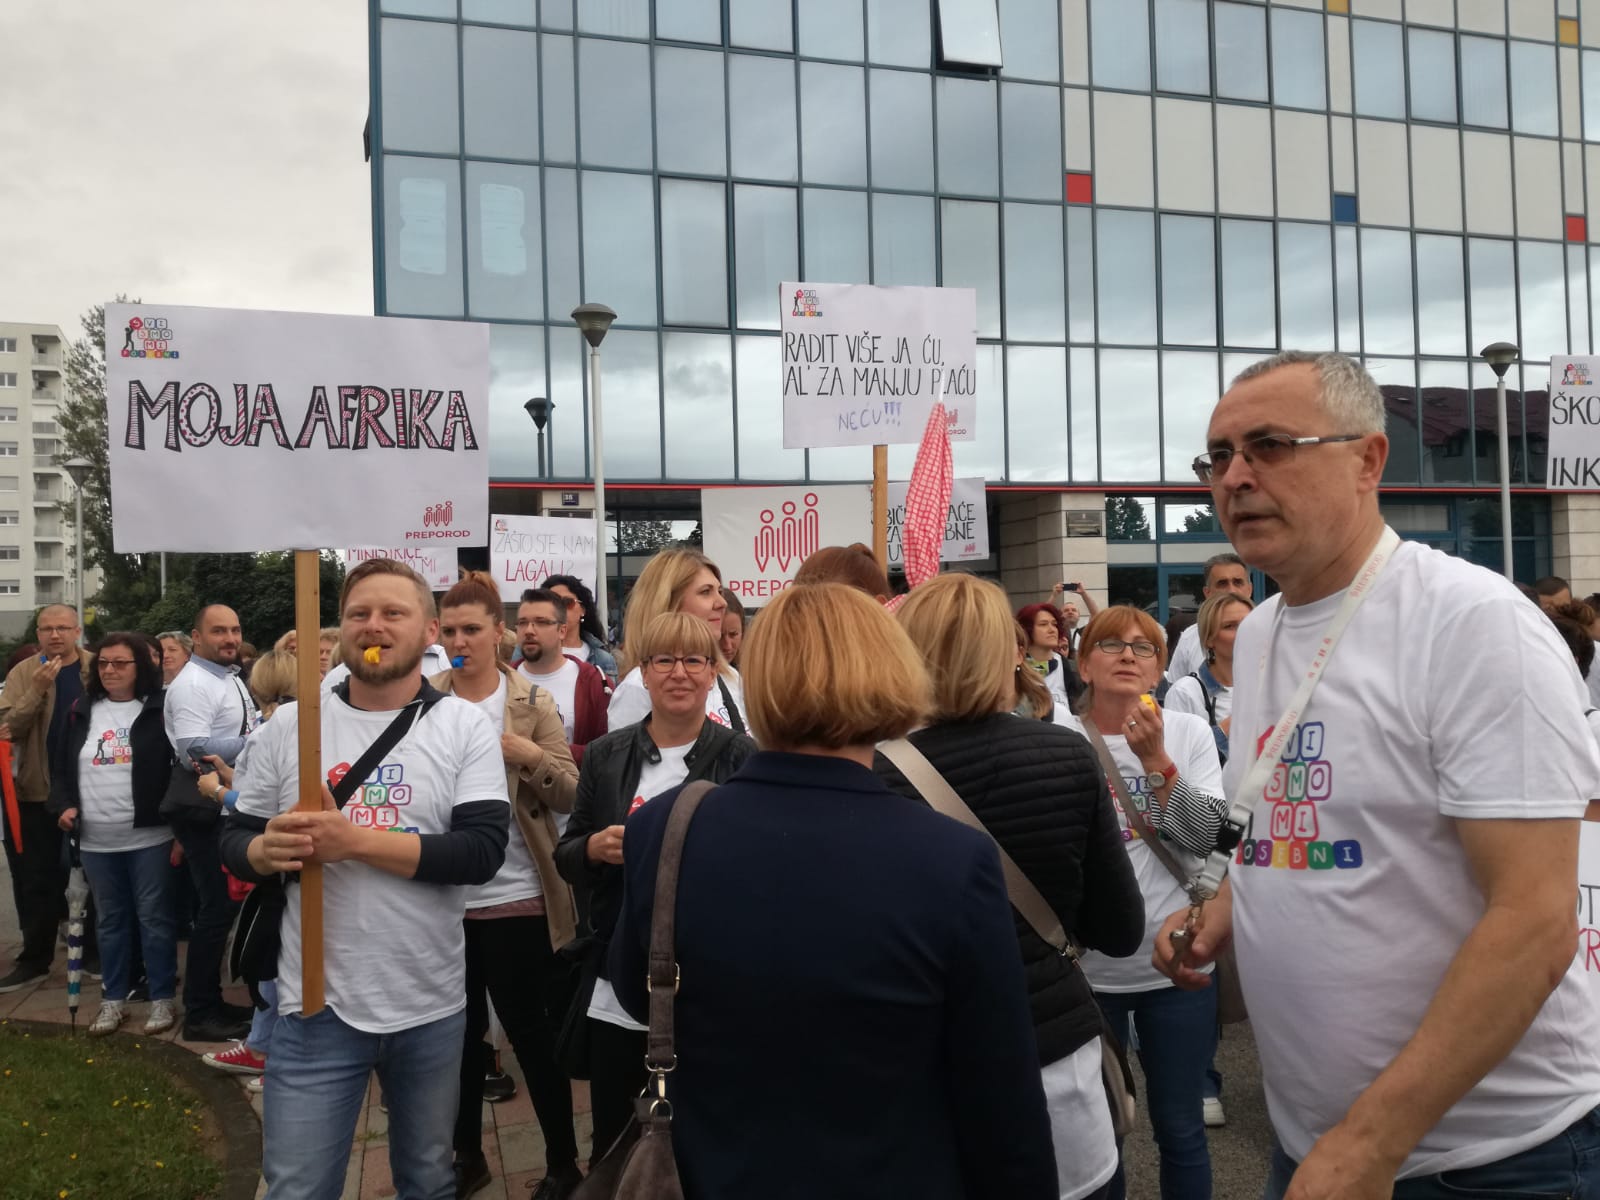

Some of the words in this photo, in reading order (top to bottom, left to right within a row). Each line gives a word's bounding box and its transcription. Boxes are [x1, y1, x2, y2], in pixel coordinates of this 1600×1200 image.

[784, 331, 839, 363] RADIT
[845, 331, 884, 364] VIŠE
[891, 336, 912, 365] JA
[816, 366, 844, 396] ZA
[853, 367, 922, 397] MANJU
[930, 363, 977, 396] PAĆU
[125, 379, 295, 452] MOJA
[294, 384, 480, 452] AFRIKA
[404, 530, 471, 540] PREPOROD
[494, 529, 533, 554] ZAŠTO
[536, 533, 559, 555] STE
[563, 535, 594, 556] NAM
[1268, 765, 1328, 797] SMO
[354, 809, 391, 825] MI
[1274, 806, 1310, 837] MI
[1238, 842, 1357, 866] OSEBNI
